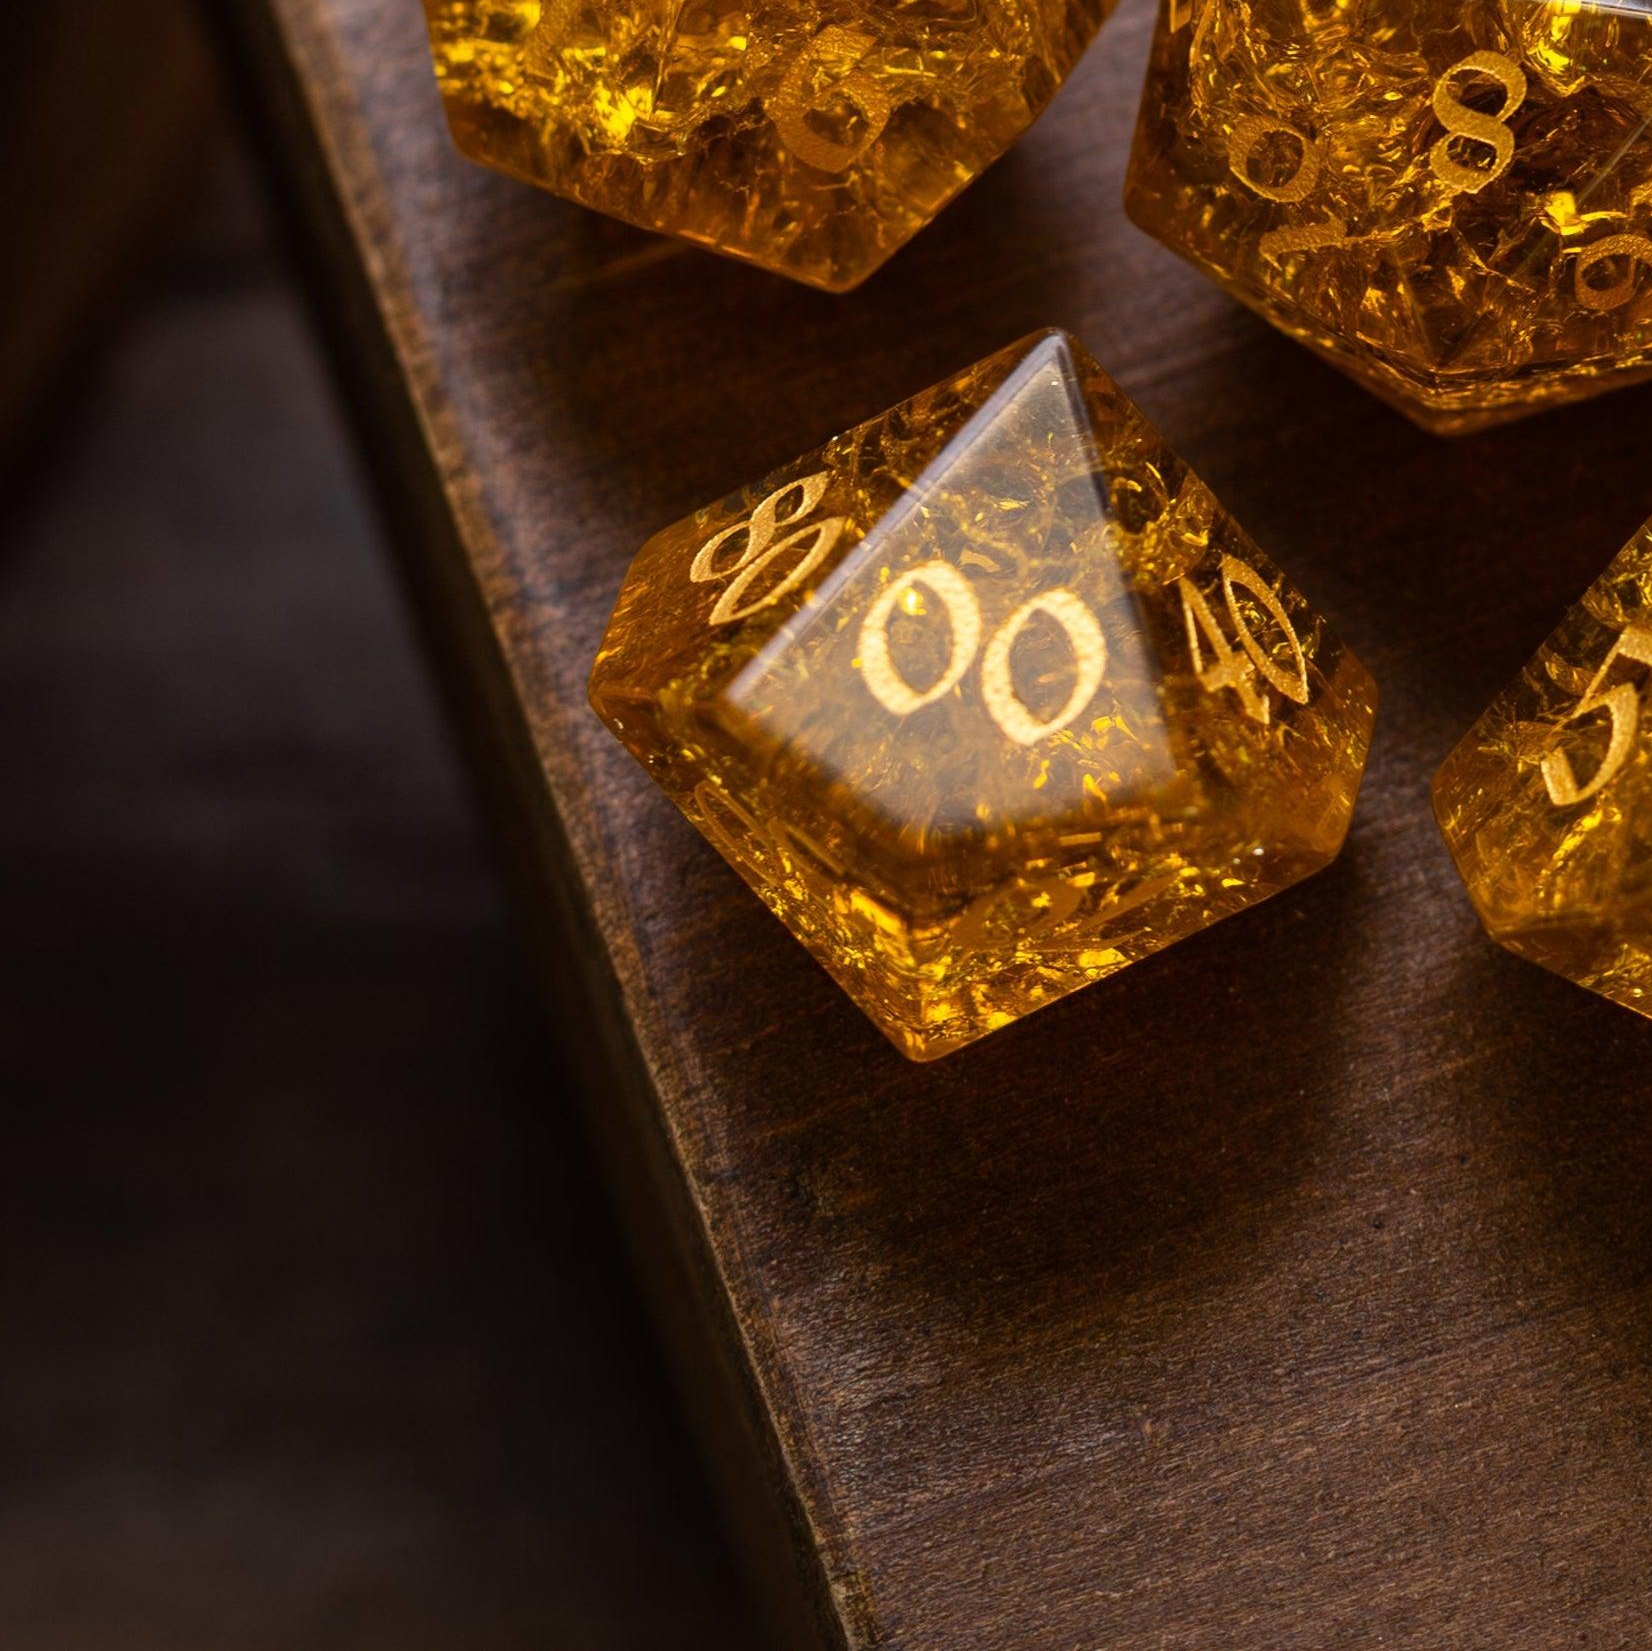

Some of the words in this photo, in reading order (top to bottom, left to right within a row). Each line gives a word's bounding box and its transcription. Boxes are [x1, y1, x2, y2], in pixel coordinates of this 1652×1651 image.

[1429, 50, 1528, 194] 8
[689, 471, 847, 626] 80
[858, 560, 1108, 746] 00
[1178, 552, 1310, 725] 40
